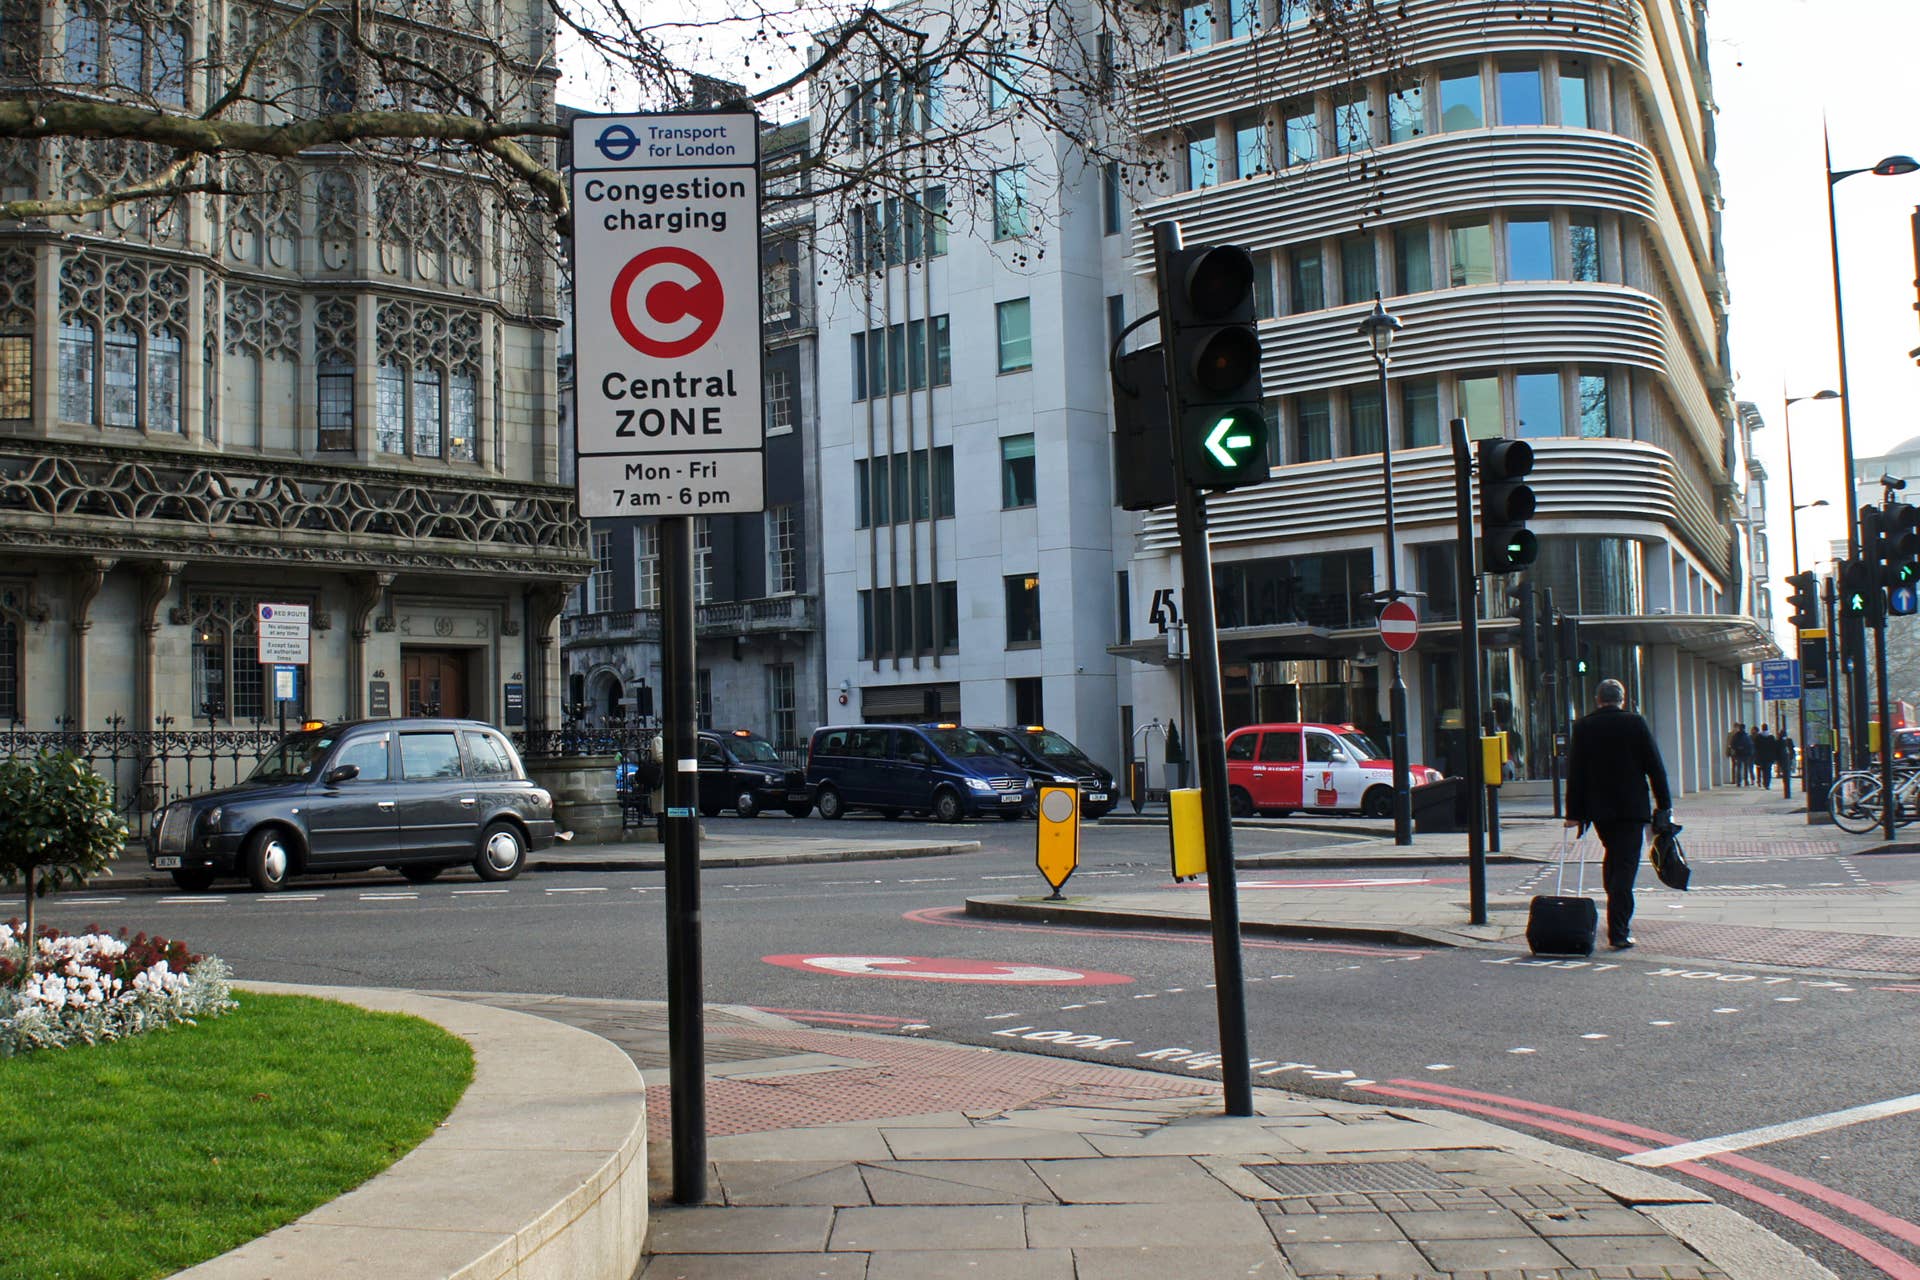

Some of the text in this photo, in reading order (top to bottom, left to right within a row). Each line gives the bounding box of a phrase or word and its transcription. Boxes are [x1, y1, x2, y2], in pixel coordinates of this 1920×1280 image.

[648, 126, 727, 141] Transport
[648, 143, 735, 157] for London
[585, 177, 746, 204] Congestion
[603, 206, 727, 234] charging
[602, 369, 737, 401] Central
[615, 407, 723, 438] ZONE
[625, 463, 670, 481] Mon
[689, 460, 717, 479] Fri
[1149, 588, 1178, 634] 45
[373, 669, 385, 678] 46
[511, 671, 522, 680] 46
[1480, 956, 1793, 985] LOOK LEFT
[991, 1026, 1135, 1050] LOOK
